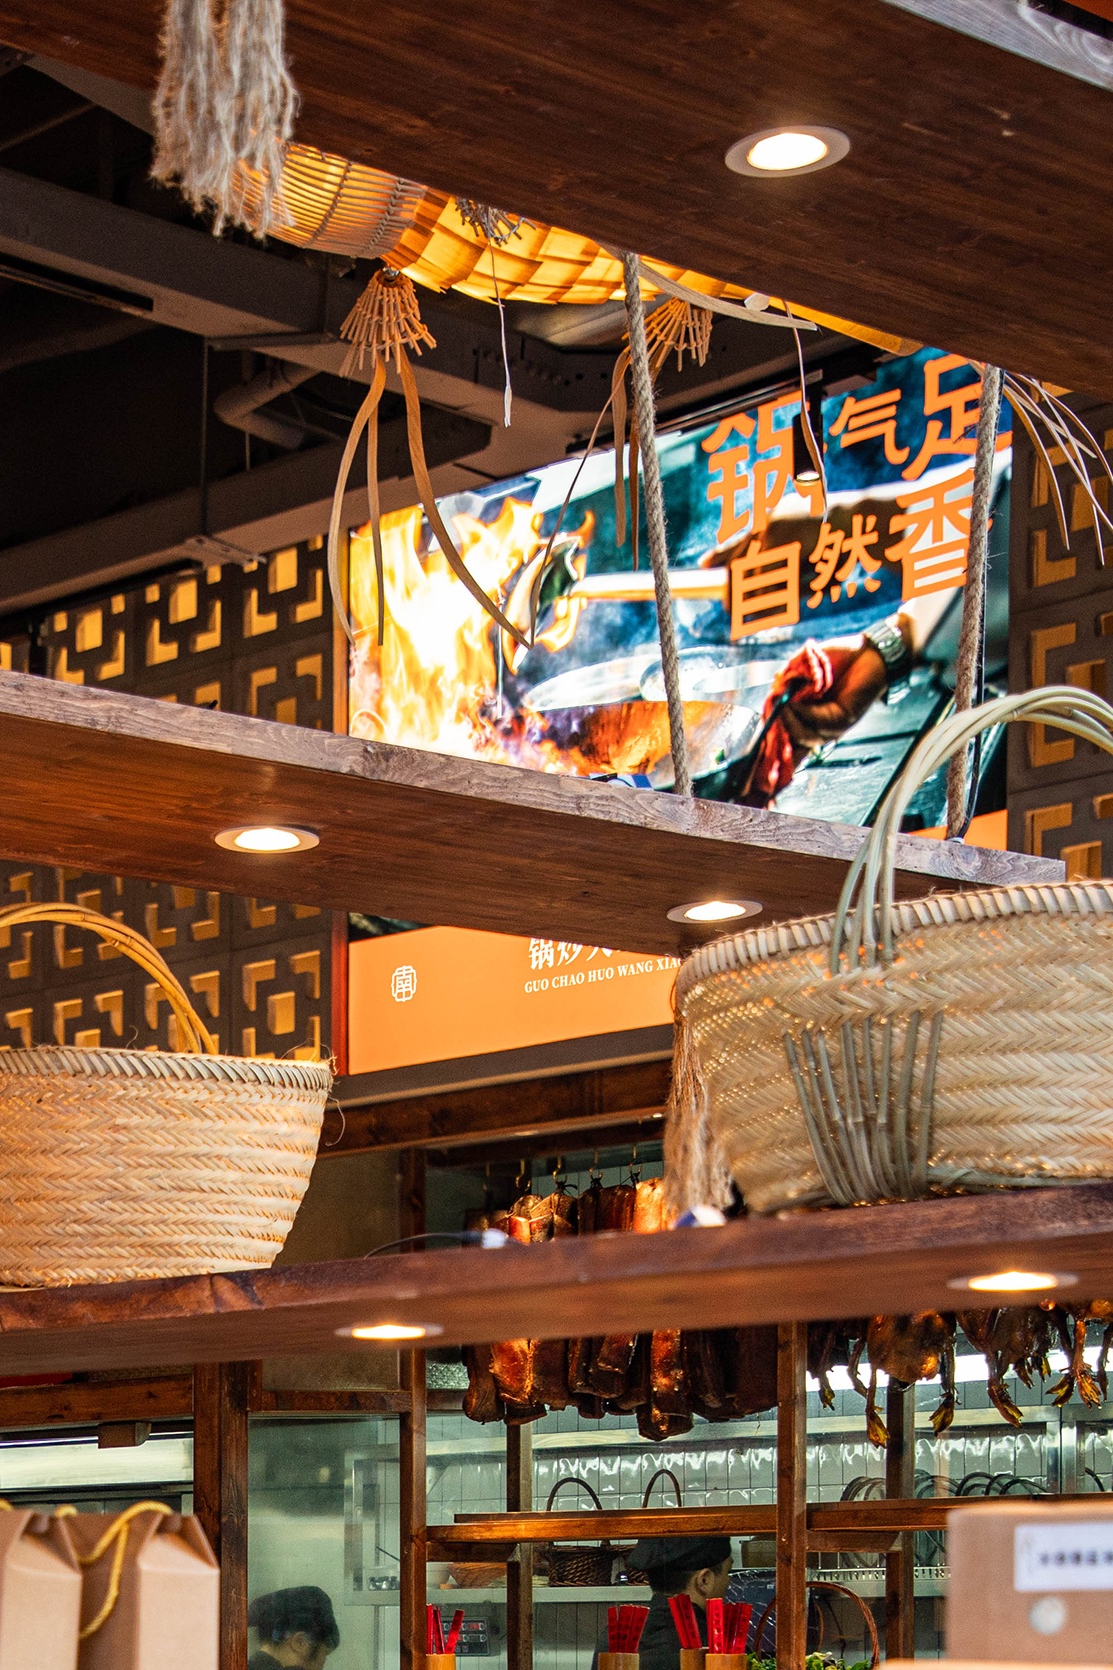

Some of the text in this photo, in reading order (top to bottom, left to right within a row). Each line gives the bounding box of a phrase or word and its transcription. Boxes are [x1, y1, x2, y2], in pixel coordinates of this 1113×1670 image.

[730, 468, 993, 641] 自然香
[524, 978, 549, 993] GUO
[552, 972, 584, 989] CHAO
[588, 968, 614, 982] HUO
[618, 961, 653, 977] WANG
